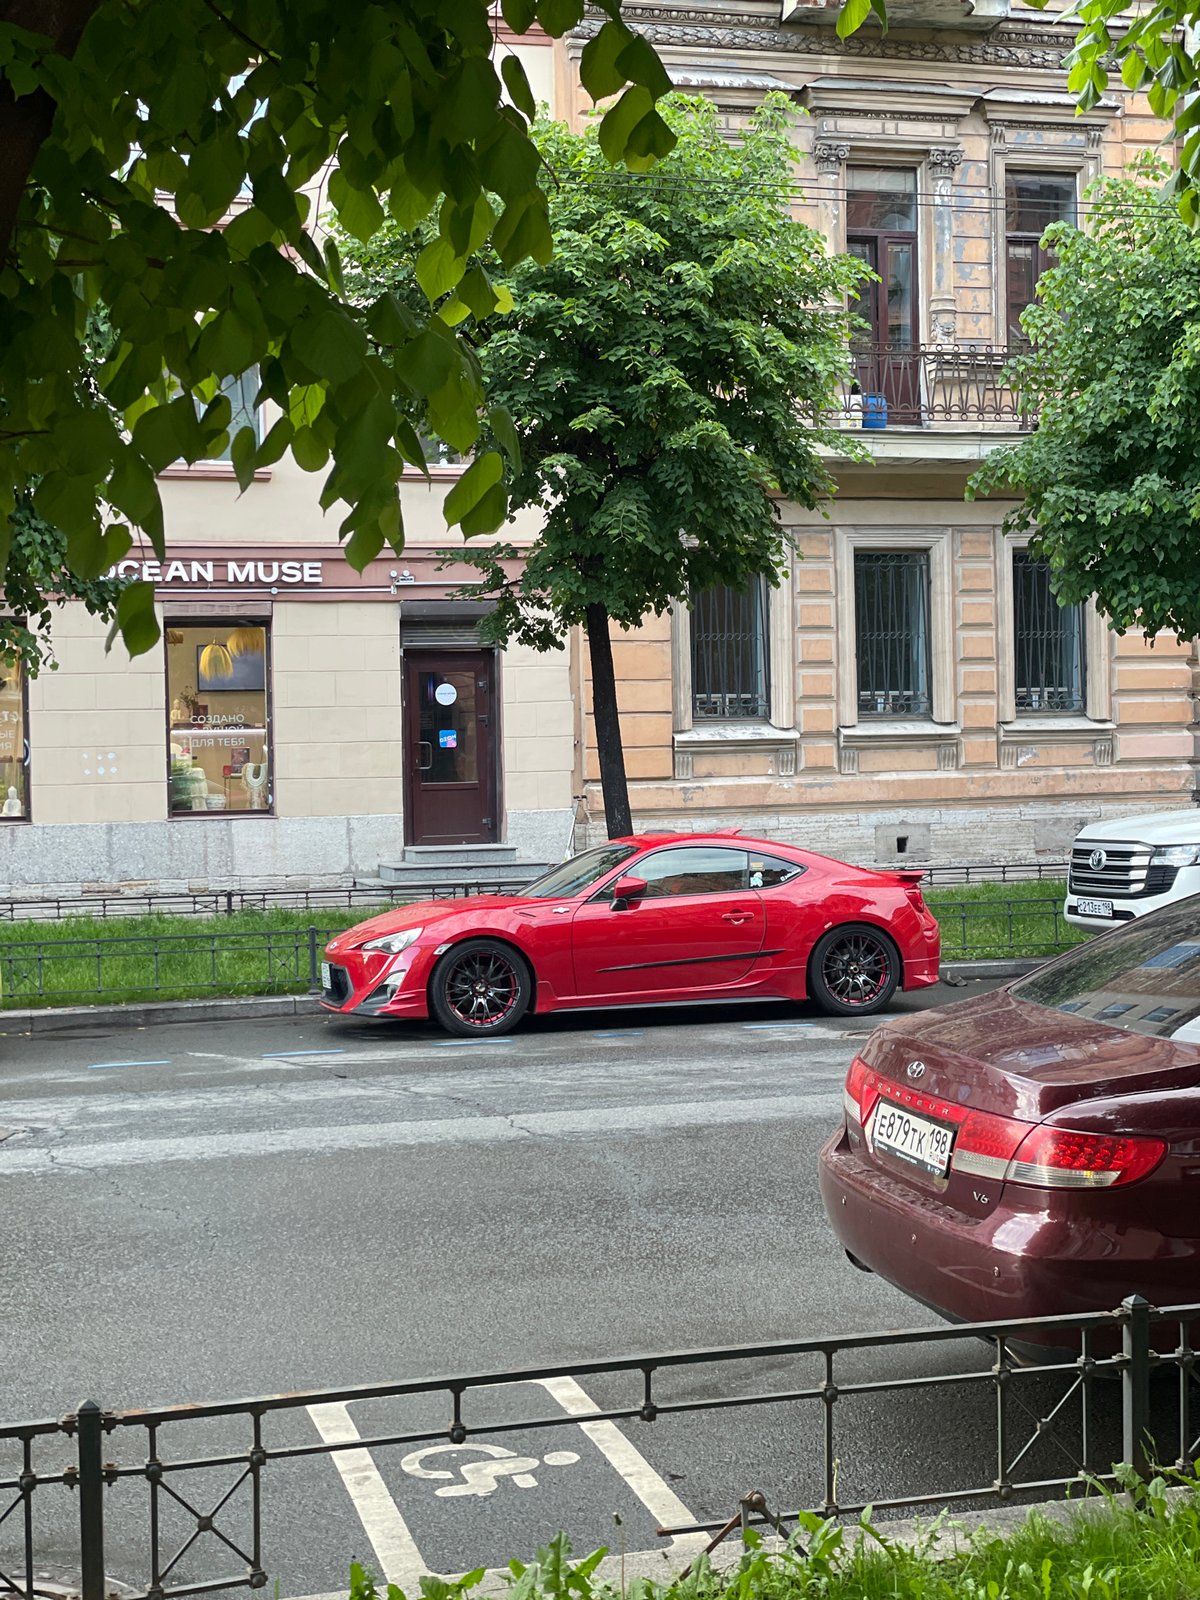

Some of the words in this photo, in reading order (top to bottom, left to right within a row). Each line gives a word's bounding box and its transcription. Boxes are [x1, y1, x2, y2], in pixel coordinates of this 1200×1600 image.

[227, 561, 323, 583] MUSE
[190, 714, 245, 724] СОЗДАНО
[192, 738, 214, 748] ДЛЯ
[217, 737, 245, 747] ТЕБЯ
[877, 1112, 926, 1154] E879TK
[929, 1128, 948, 1155] 198
[972, 1191, 989, 1204] V6
